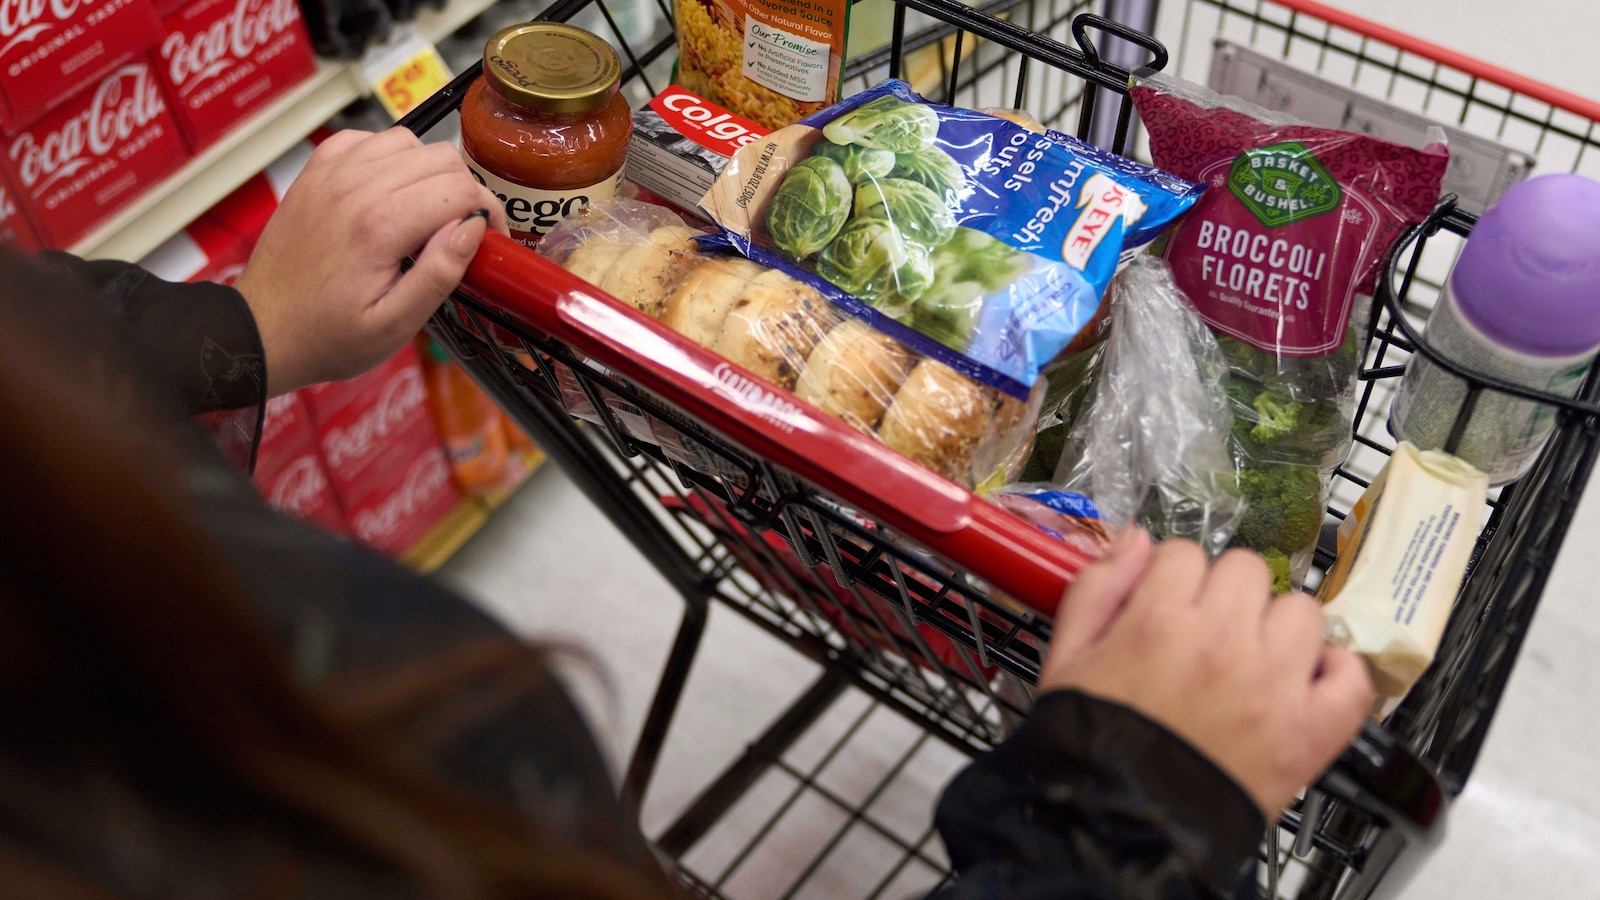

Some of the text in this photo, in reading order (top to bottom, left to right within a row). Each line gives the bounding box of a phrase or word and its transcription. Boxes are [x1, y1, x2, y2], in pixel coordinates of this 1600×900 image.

[748, 3, 770, 20] Other
[770, 14, 804, 32] Natural
[804, 25, 833, 40] Flavor
[800, 9, 833, 27] Sauce
[751, 24, 820, 56] Our Promise
[758, 43, 824, 70] No Artificial Flavors
[765, 54, 809, 75] Preservatives
[757, 61, 807, 85] No Added MSG
[8, 62, 166, 189] Coca-Cola
[662, 94, 765, 148] Colga
[759, 153, 772, 168] WT
[763, 141, 778, 157] NET
[752, 164, 767, 181] 10.8
[1003, 136, 1054, 192] ssels
[1250, 156, 1319, 183] BASKET
[747, 177, 760, 190] OZ
[1243, 184, 1308, 210] BUSHEL
[1274, 178, 1287, 191] &
[1012, 157, 1086, 244] mfresh
[1071, 206, 1111, 252] EYE
[1196, 220, 1326, 281] BROCCOLI
[1201, 255, 1310, 311] FLORETS
[1243, 300, 1282, 319] Guarantee
